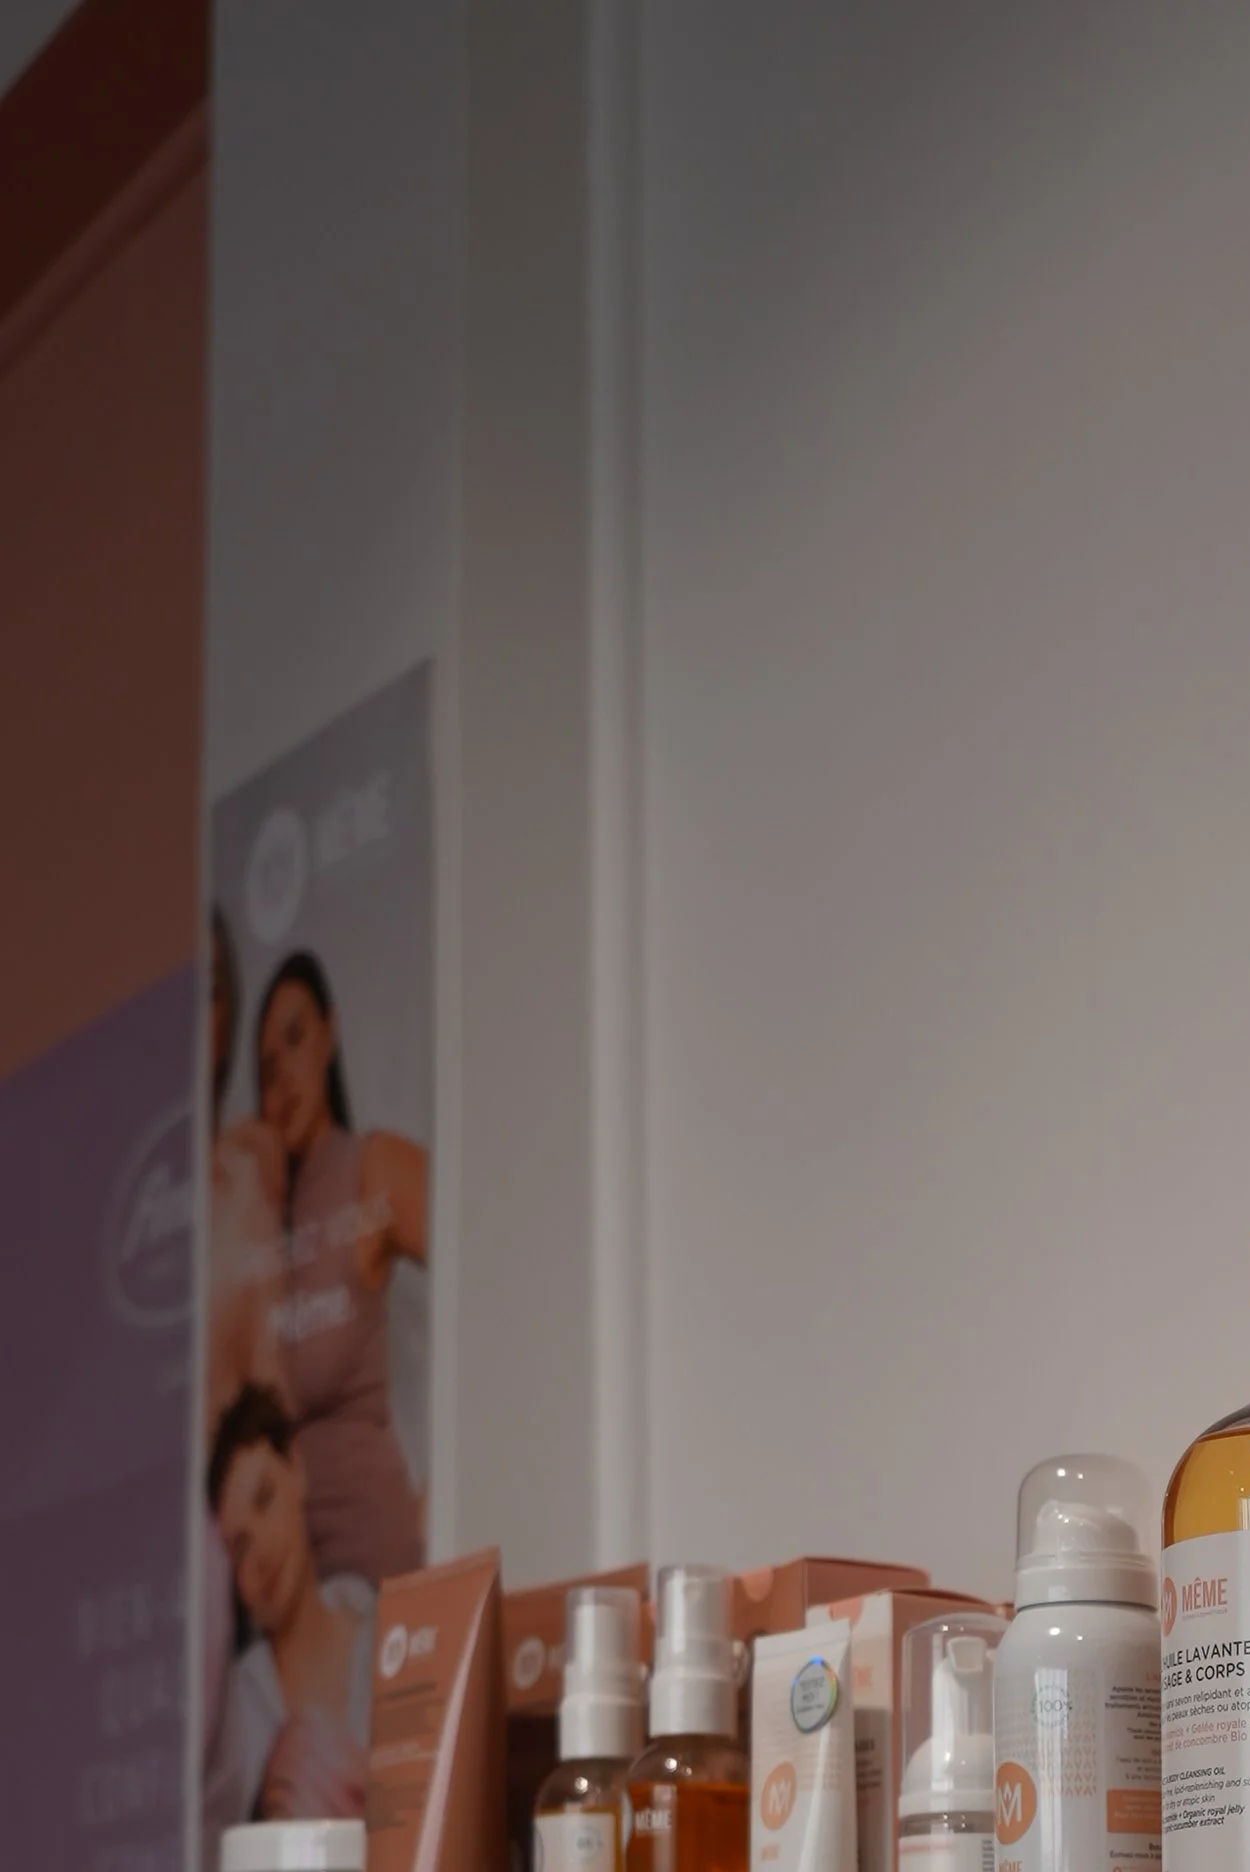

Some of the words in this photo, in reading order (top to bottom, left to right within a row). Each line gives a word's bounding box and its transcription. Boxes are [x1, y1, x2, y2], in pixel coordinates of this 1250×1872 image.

[1182, 1577, 1228, 1613] MÊME
[1185, 1669, 1193, 1684] &
[1196, 1661, 1246, 1682] CORPS
[1234, 1687, 1244, 1698] et
[1217, 1702, 1229, 1712] ou
[1217, 1718, 1247, 1733] royale
[1227, 1804, 1246, 1816] jelly
[634, 1809, 673, 1832] MÊME
